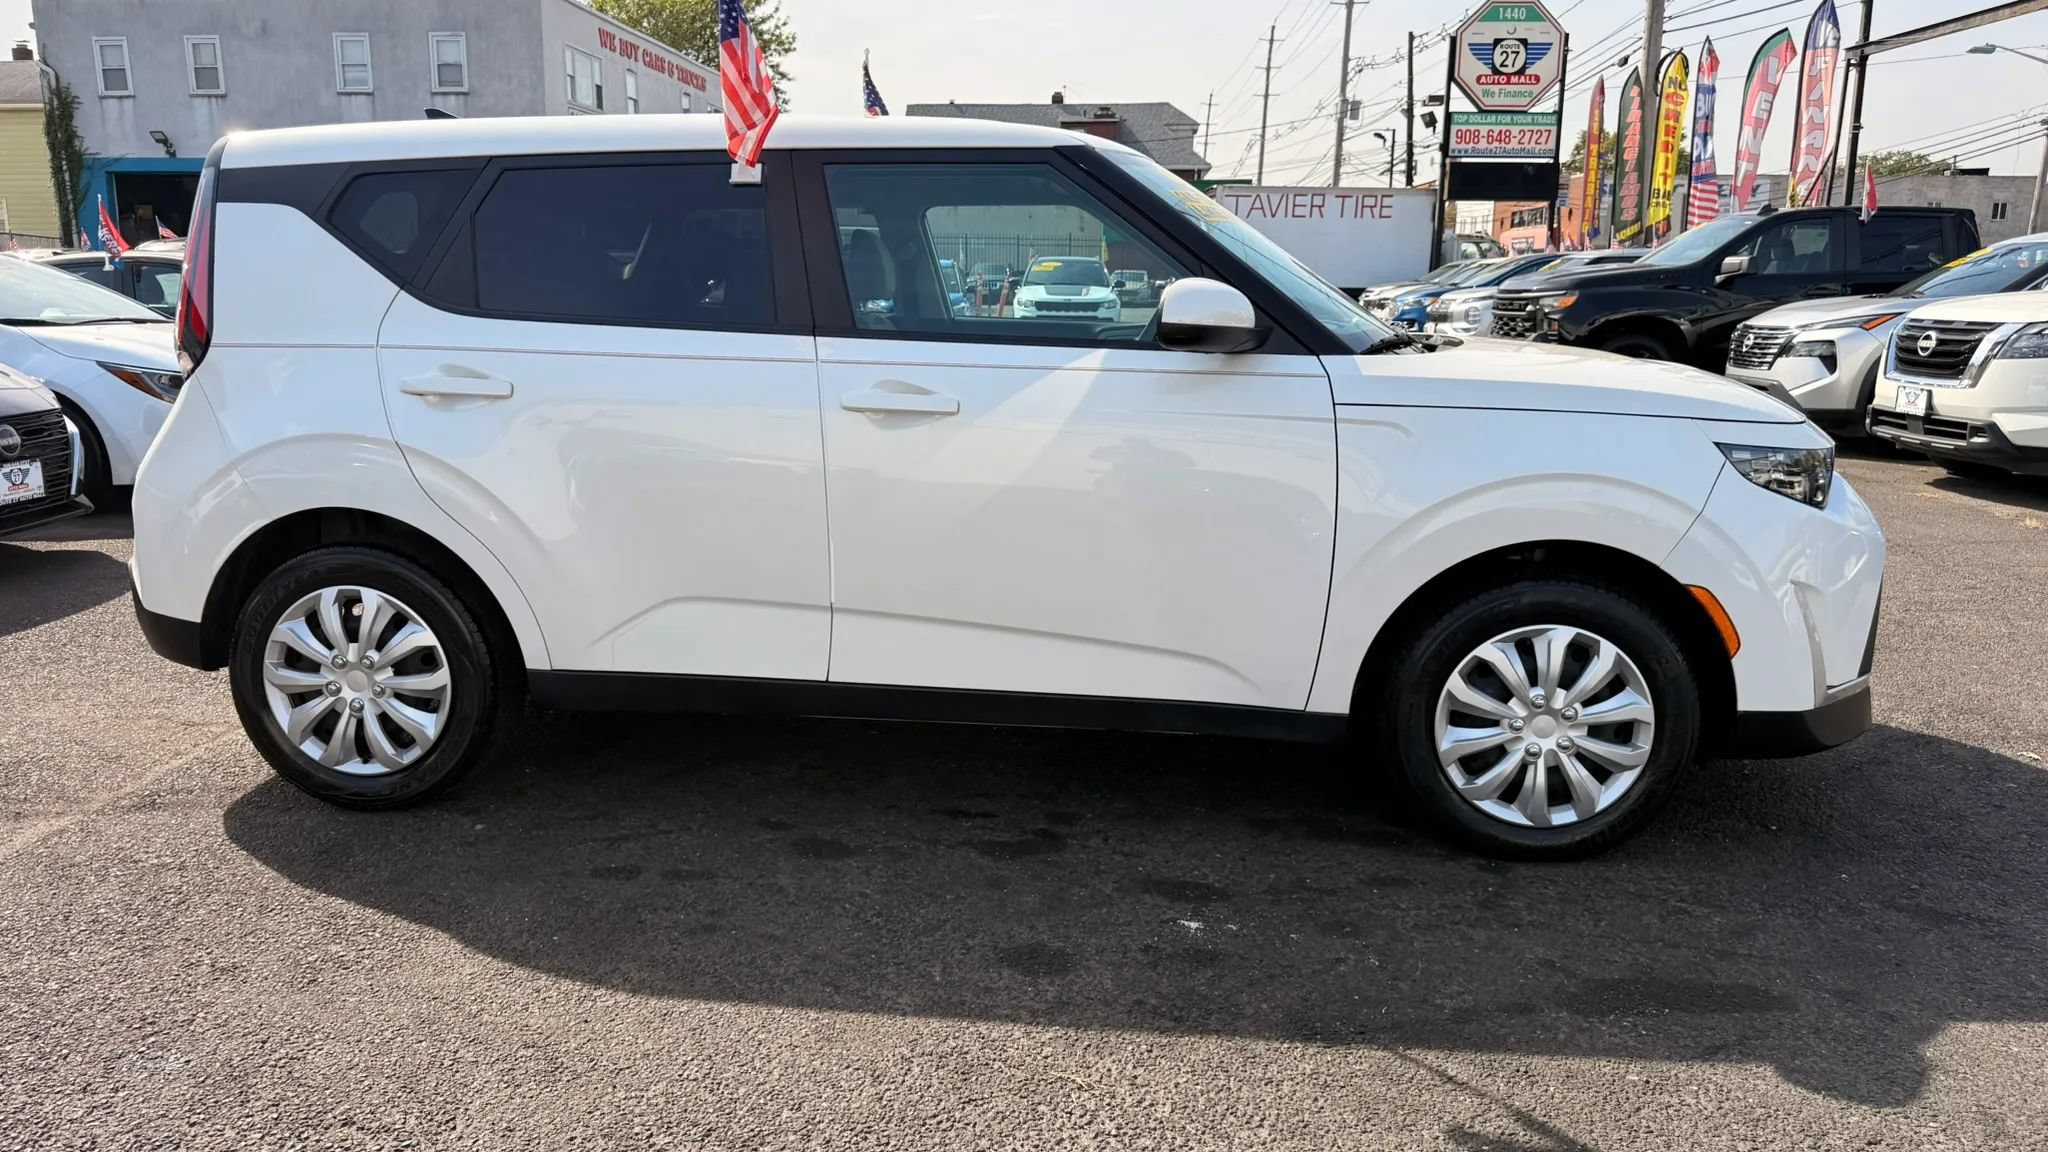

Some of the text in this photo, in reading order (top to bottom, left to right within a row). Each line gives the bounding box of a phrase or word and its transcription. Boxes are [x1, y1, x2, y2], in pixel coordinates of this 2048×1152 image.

[1499, 7, 1526, 20] 1440
[598, 27, 617, 51] WE
[619, 36, 640, 63] BUY
[642, 48, 666, 74] CARS
[676, 63, 707, 93] TRUCKS
[1498, 50, 1520, 68] 27
[1479, 75, 1537, 84] AUTO MALL
[1481, 88, 1534, 98] We Finance
[1453, 114, 1557, 124] TOP DOLLAR FOR YOUR TRADE
[1455, 128, 1553, 145] 908-648-2727
[1659, 91, 1685, 186] CREDIT
[1450, 146, 1554, 155] www.Route27AutoMall.com
[1224, 192, 1325, 219] TAVIER
[1335, 194, 1395, 219] TIRE
